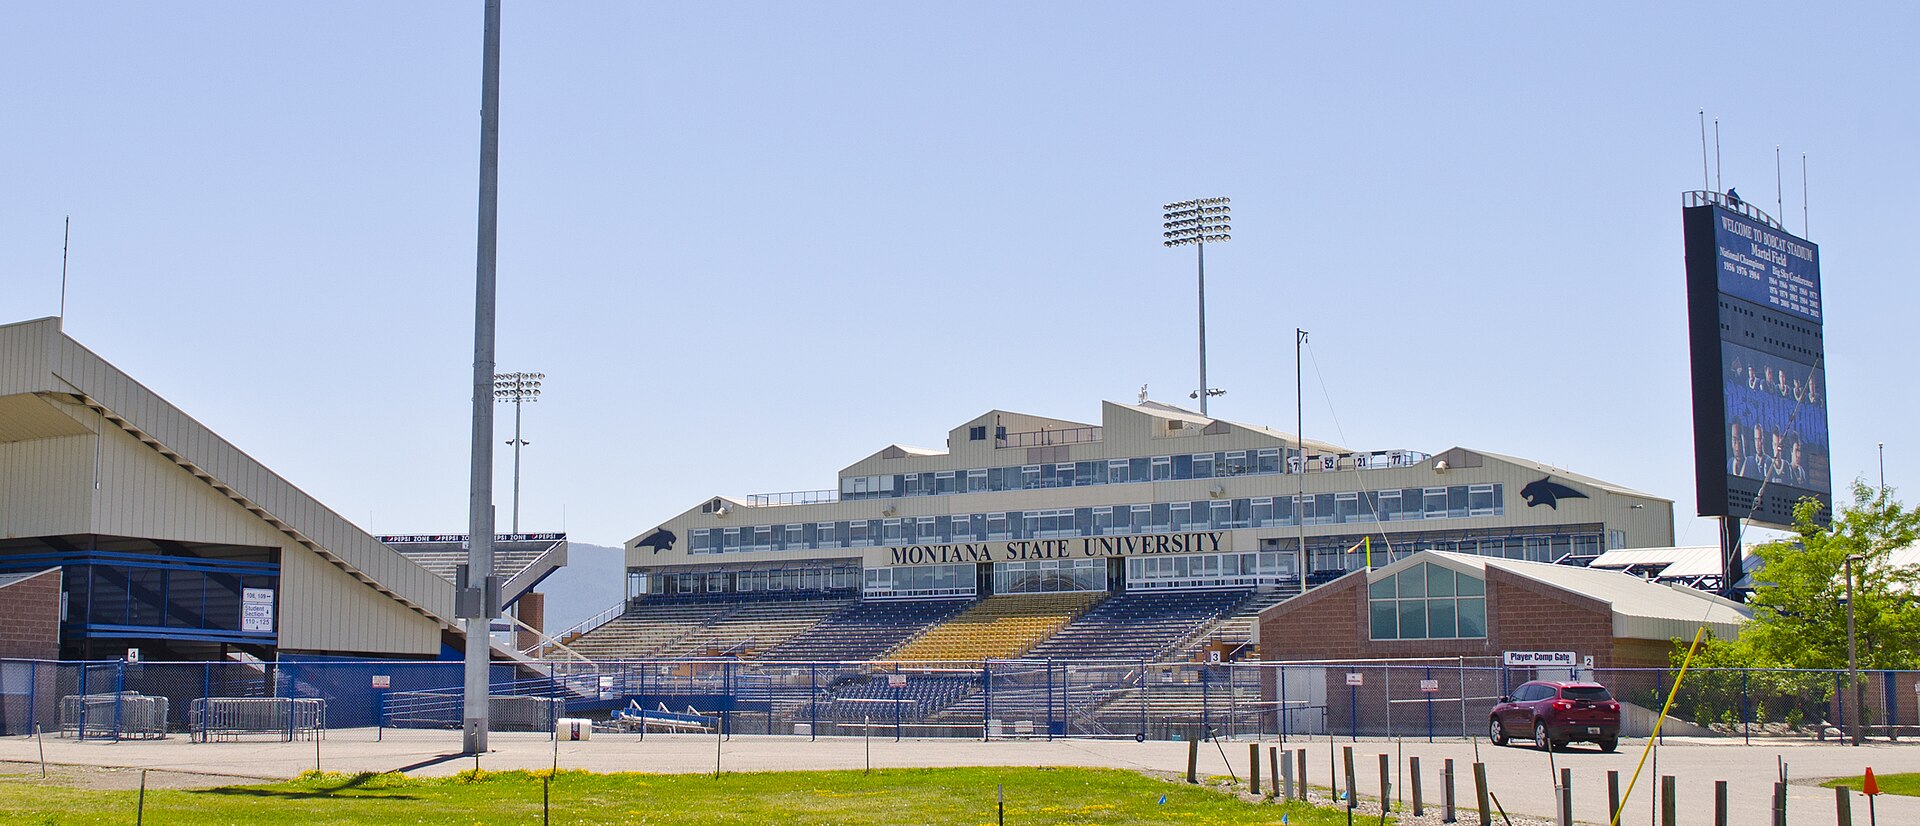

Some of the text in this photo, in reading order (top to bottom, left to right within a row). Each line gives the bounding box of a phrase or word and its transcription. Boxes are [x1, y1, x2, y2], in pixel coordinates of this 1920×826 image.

[1721, 216, 1813, 262] WELCOME TO BOBCAT STADIUM
[1720, 246, 1765, 271] National Champions
[1751, 243, 1787, 267] Martel Field
[1772, 266, 1813, 288] Big Sky Conference
[1325, 459, 1334, 469] 52
[1358, 457, 1366, 467] 21
[1392, 455, 1401, 465] 77
[890, 532, 1224, 565] MONTANA STATE UNIVERSITY
[130, 651, 136, 659] 4
[1212, 653, 1219, 662] 3
[1510, 653, 1570, 662] Player Comp Gate
[1586, 658, 1592, 666] 2
